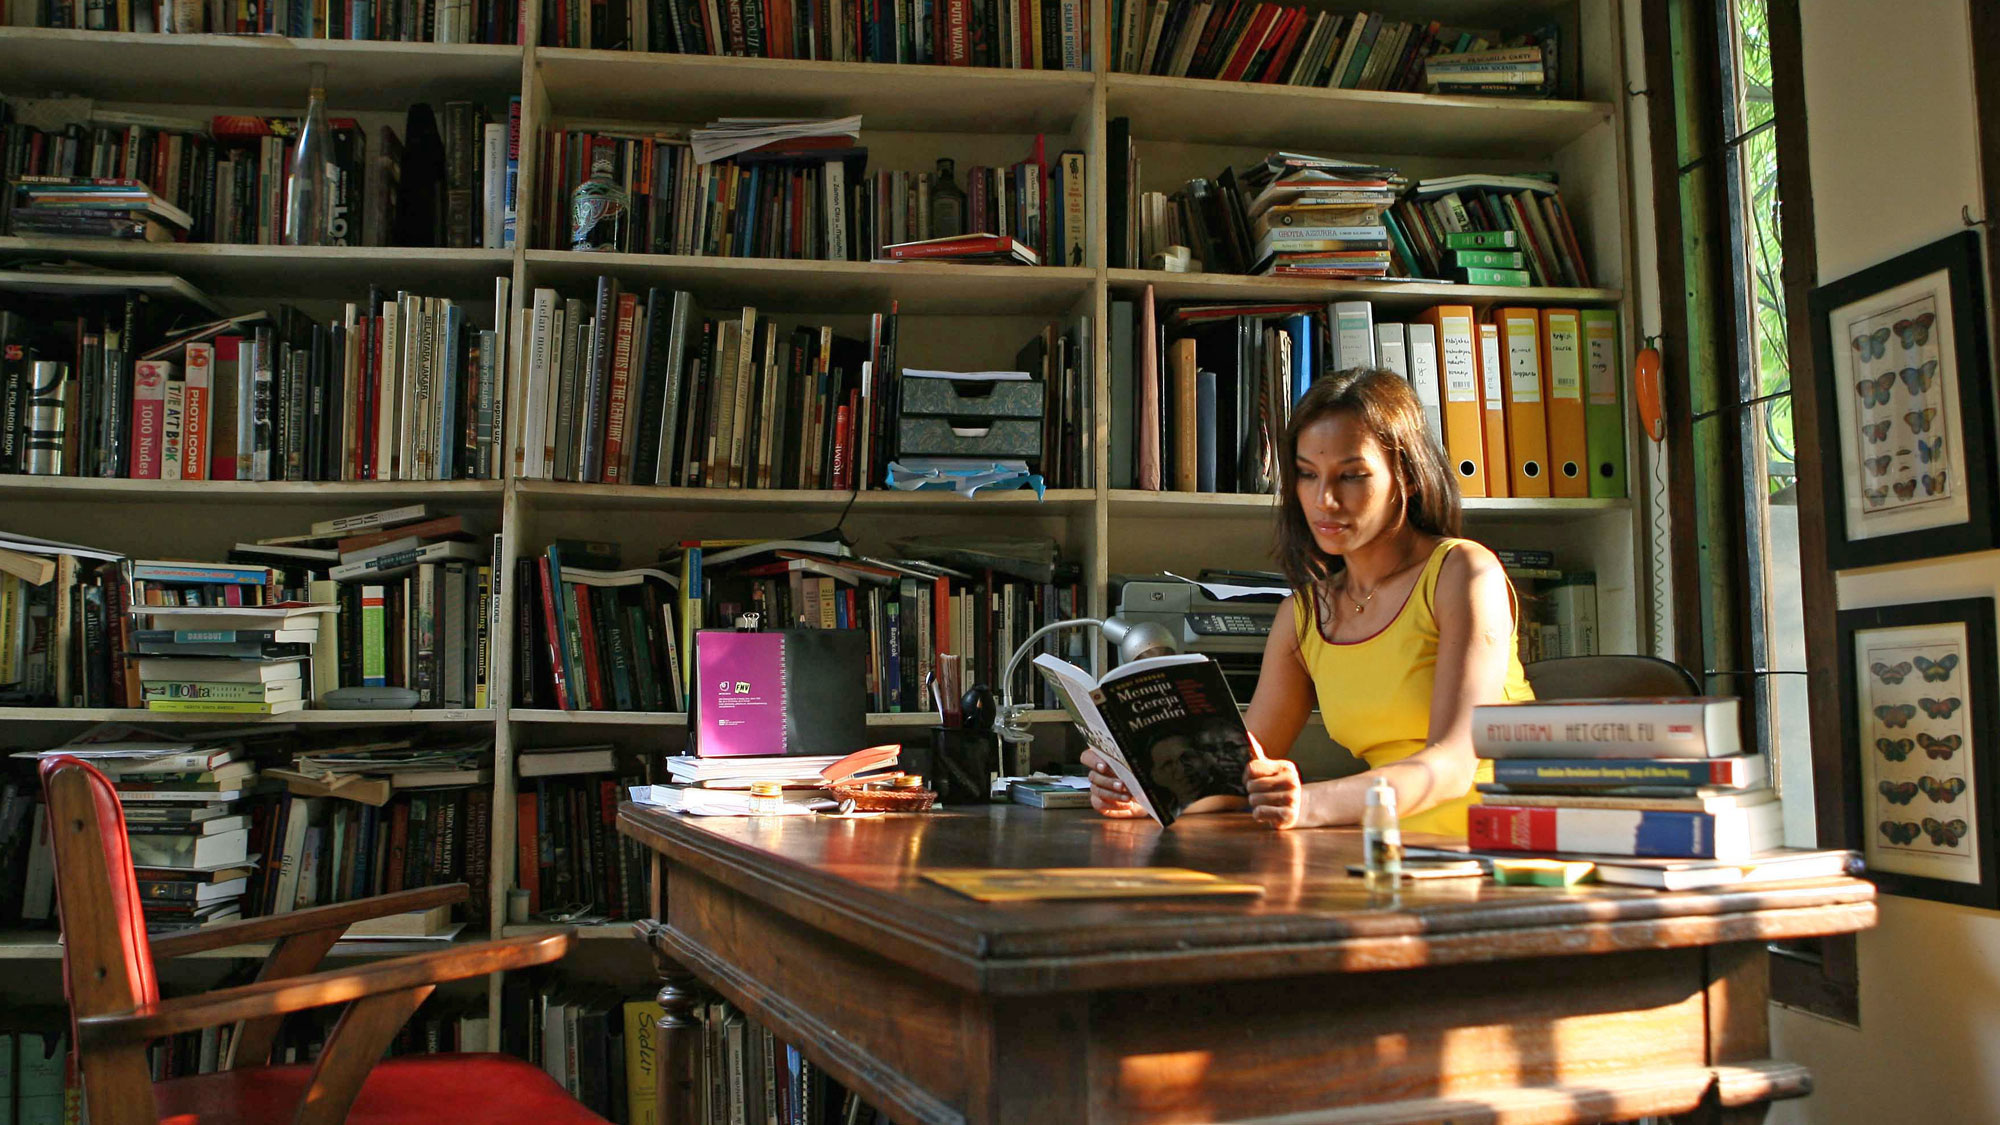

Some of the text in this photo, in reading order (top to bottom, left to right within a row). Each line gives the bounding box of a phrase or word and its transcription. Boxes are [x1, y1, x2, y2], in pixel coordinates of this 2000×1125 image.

[952, 1, 964, 60] PUTU WIJAYA
[1064, 3, 1075, 69] SALMAN RUSHDIE
[601, 287, 609, 320] SACRED
[420, 315, 432, 400] BELANTARA JAKARTA
[536, 299, 549, 370] stefan moses
[598, 327, 606, 359] LEGACY
[608, 316, 633, 443] THE PHOTOS OF THE CENTURY
[4, 373, 18, 456] THE POLAROID BOOK
[139, 405, 153, 475] 1000 Nudes
[188, 389, 199, 474] PHOTO ICONS
[833, 443, 844, 475] ROME
[478, 593, 488, 676] Running Dummies
[889, 627, 898, 657] Bangkok
[1116, 680, 1173, 703] Menuju
[1128, 705, 1187, 733] Mandiri
[1131, 695, 1180, 713] Gereja
[1486, 723, 1655, 742] AYU UTAMI HET GETAL FU
[638, 1012, 657, 1076] Sadur
